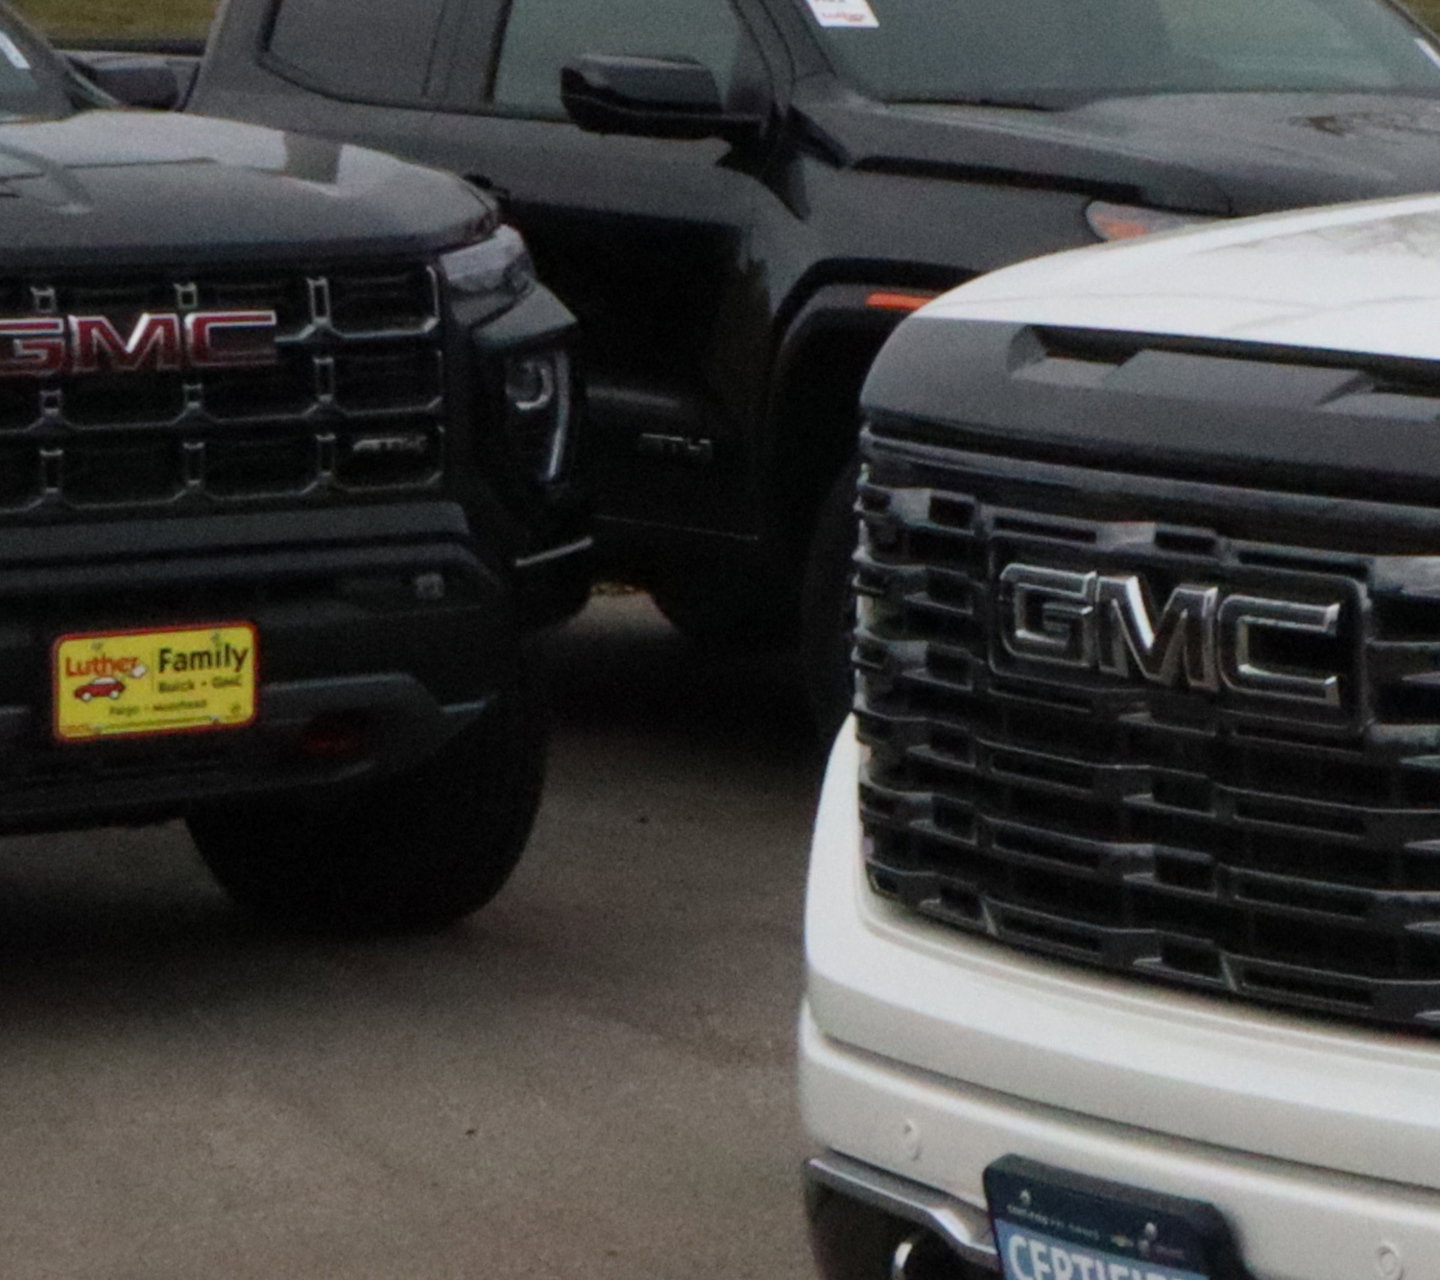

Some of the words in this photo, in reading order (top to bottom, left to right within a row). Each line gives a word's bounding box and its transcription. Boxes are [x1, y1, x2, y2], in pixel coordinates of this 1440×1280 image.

[0, 309, 276, 376] GMC
[158, 642, 249, 674] Family
[999, 562, 1342, 707] GMC
[65, 653, 139, 677] Luther
